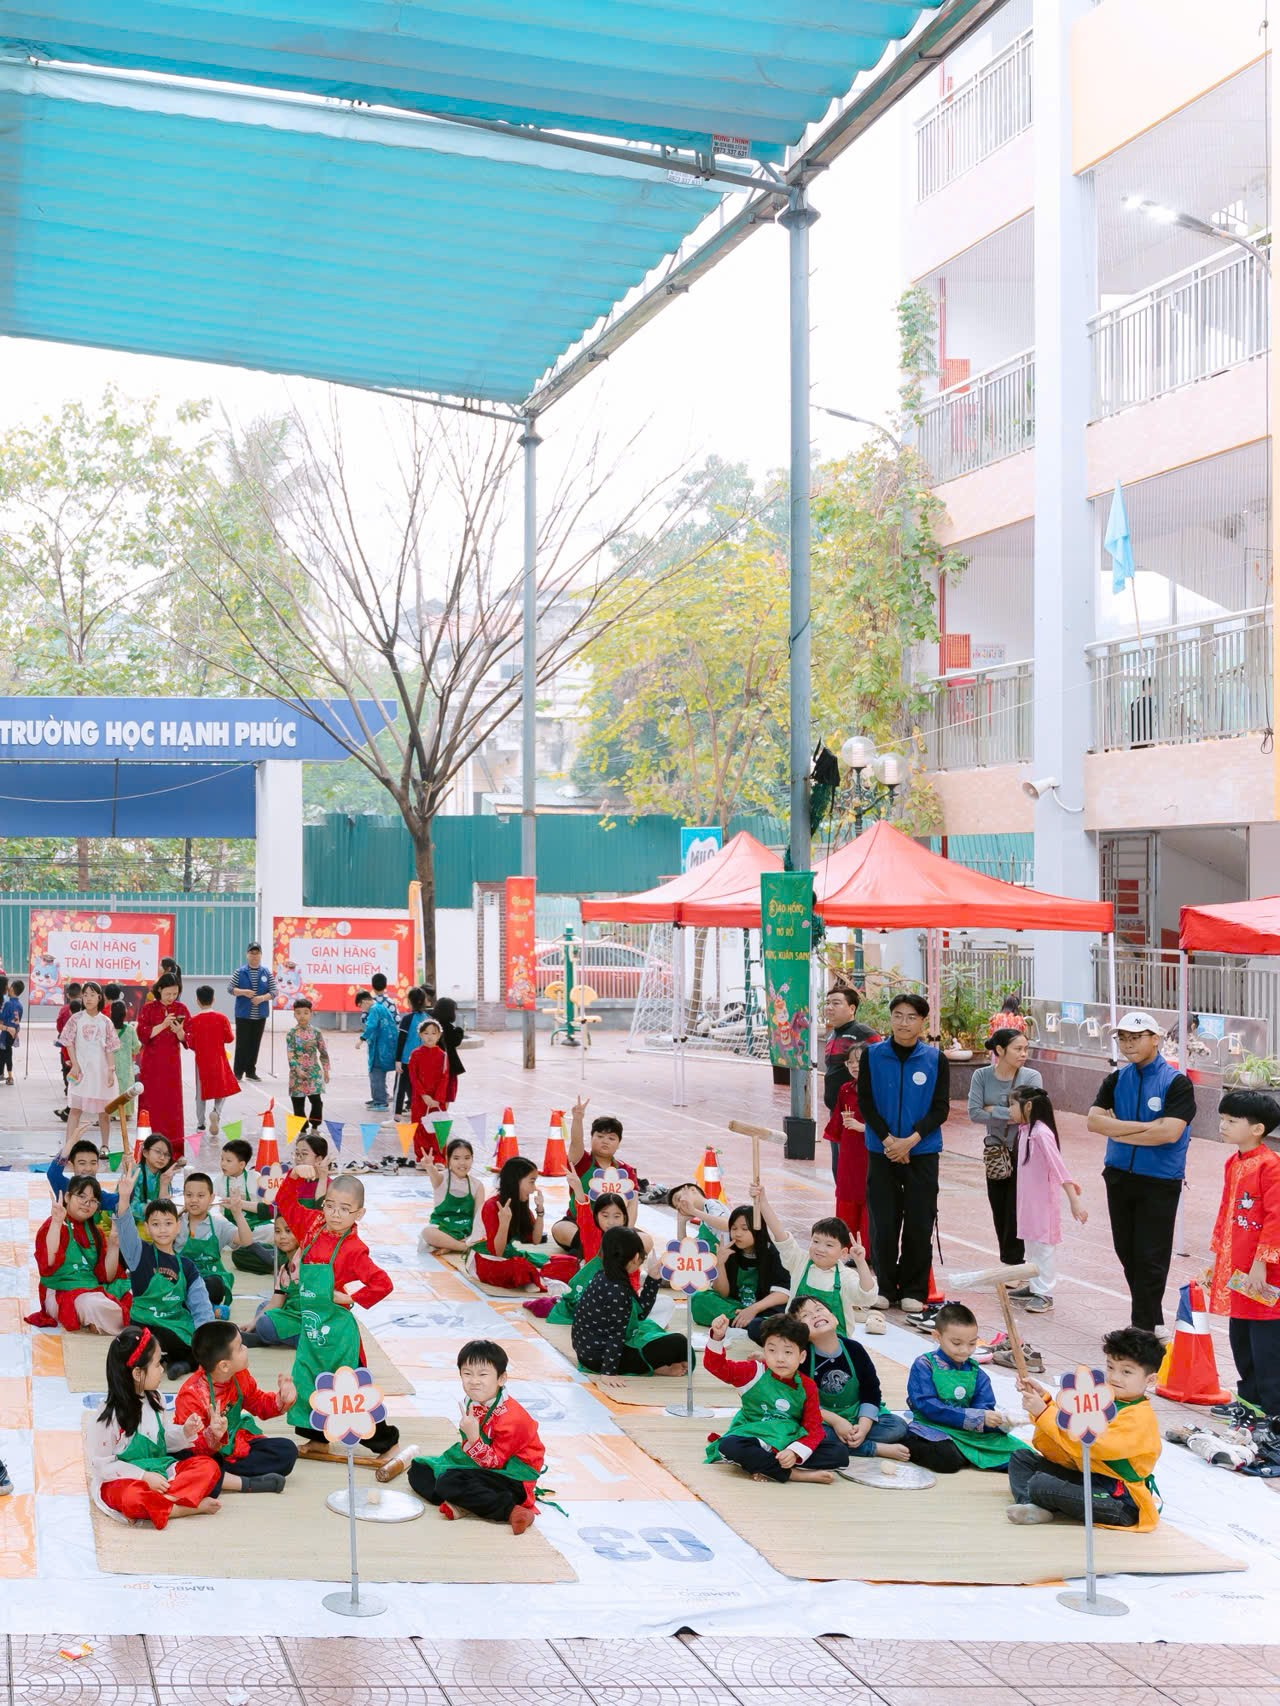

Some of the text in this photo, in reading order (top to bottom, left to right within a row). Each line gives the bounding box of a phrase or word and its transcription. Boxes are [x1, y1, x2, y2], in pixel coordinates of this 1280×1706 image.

[105, 720, 155, 752] HỌC
[160, 720, 230, 752] HẠNH
[234, 716, 297, 748] PHÚC
[70, 938, 137, 953] GIAN HÀNG
[311, 944, 377, 958] GIAN HÀNG
[64, 953, 141, 973] TRẢI NGHIỆM
[305, 960, 381, 978] TRẢI NGHIỆM
[601, 1182, 622, 1194] 5A2
[676, 1256, 702, 1272] 3A1
[329, 1393, 365, 1415] 1A2
[1073, 1393, 1100, 1414] 1A1
